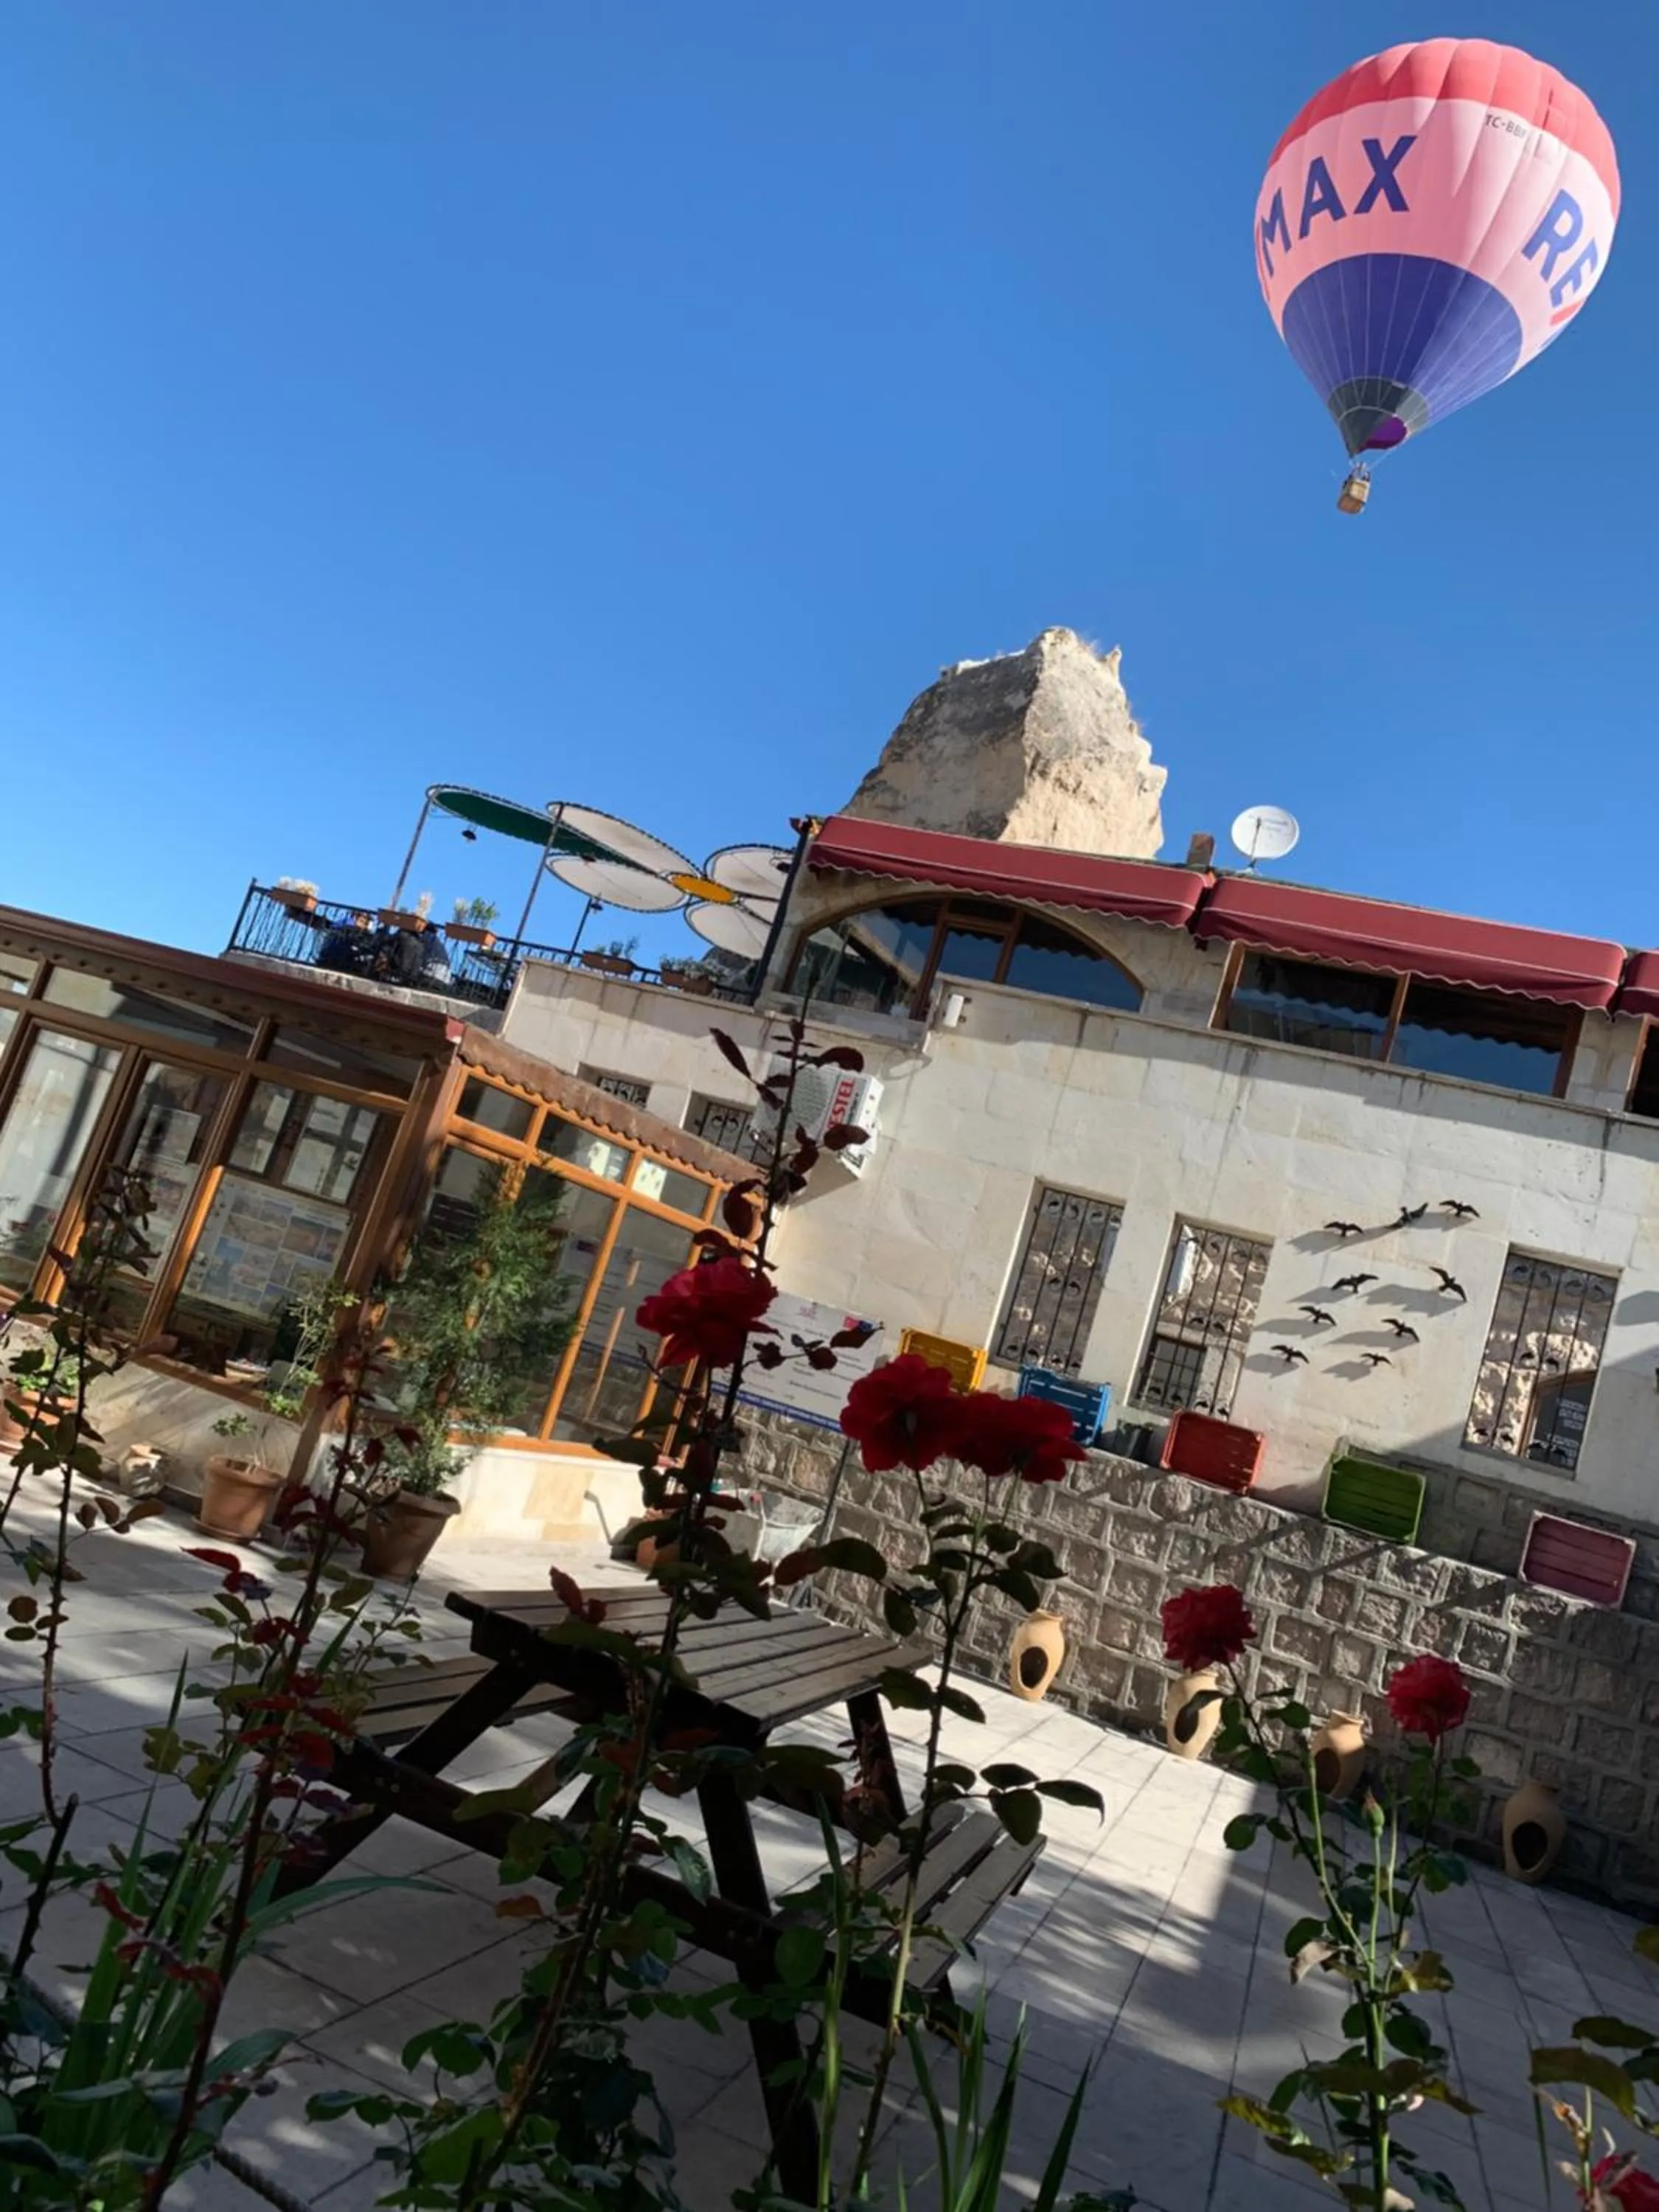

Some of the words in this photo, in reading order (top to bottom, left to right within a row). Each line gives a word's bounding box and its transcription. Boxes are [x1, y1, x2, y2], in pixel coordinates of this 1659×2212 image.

[1262, 136, 1417, 279] MAX
[1522, 189, 1599, 308] RE
[826, 1078, 855, 1130] ESTEL
